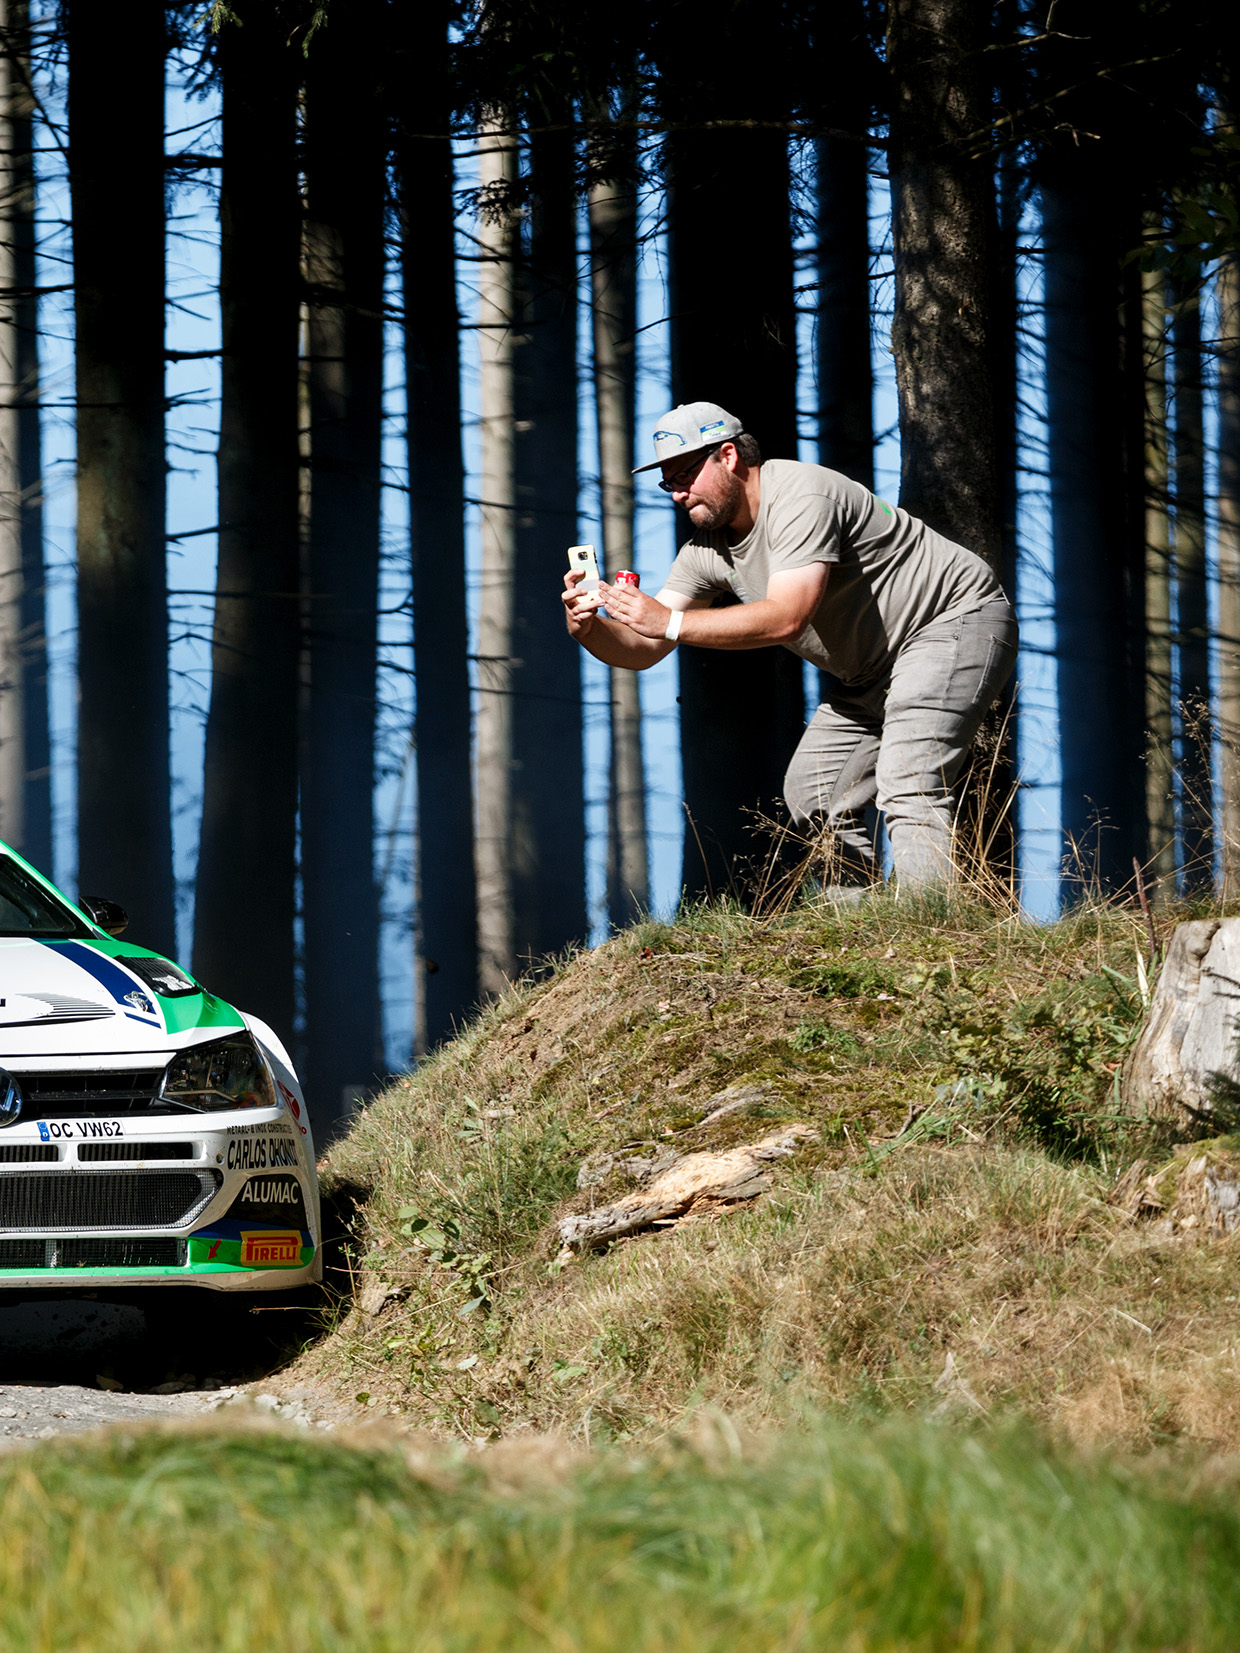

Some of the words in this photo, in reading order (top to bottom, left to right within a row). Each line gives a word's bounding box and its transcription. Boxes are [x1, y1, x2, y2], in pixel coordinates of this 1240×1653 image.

[49, 1123, 73, 1138] OC
[76, 1121, 124, 1137] VW62
[227, 1138, 266, 1169] CARLOS
[241, 1180, 299, 1205] ALUMAC
[245, 1236, 299, 1262] PIRELLI
